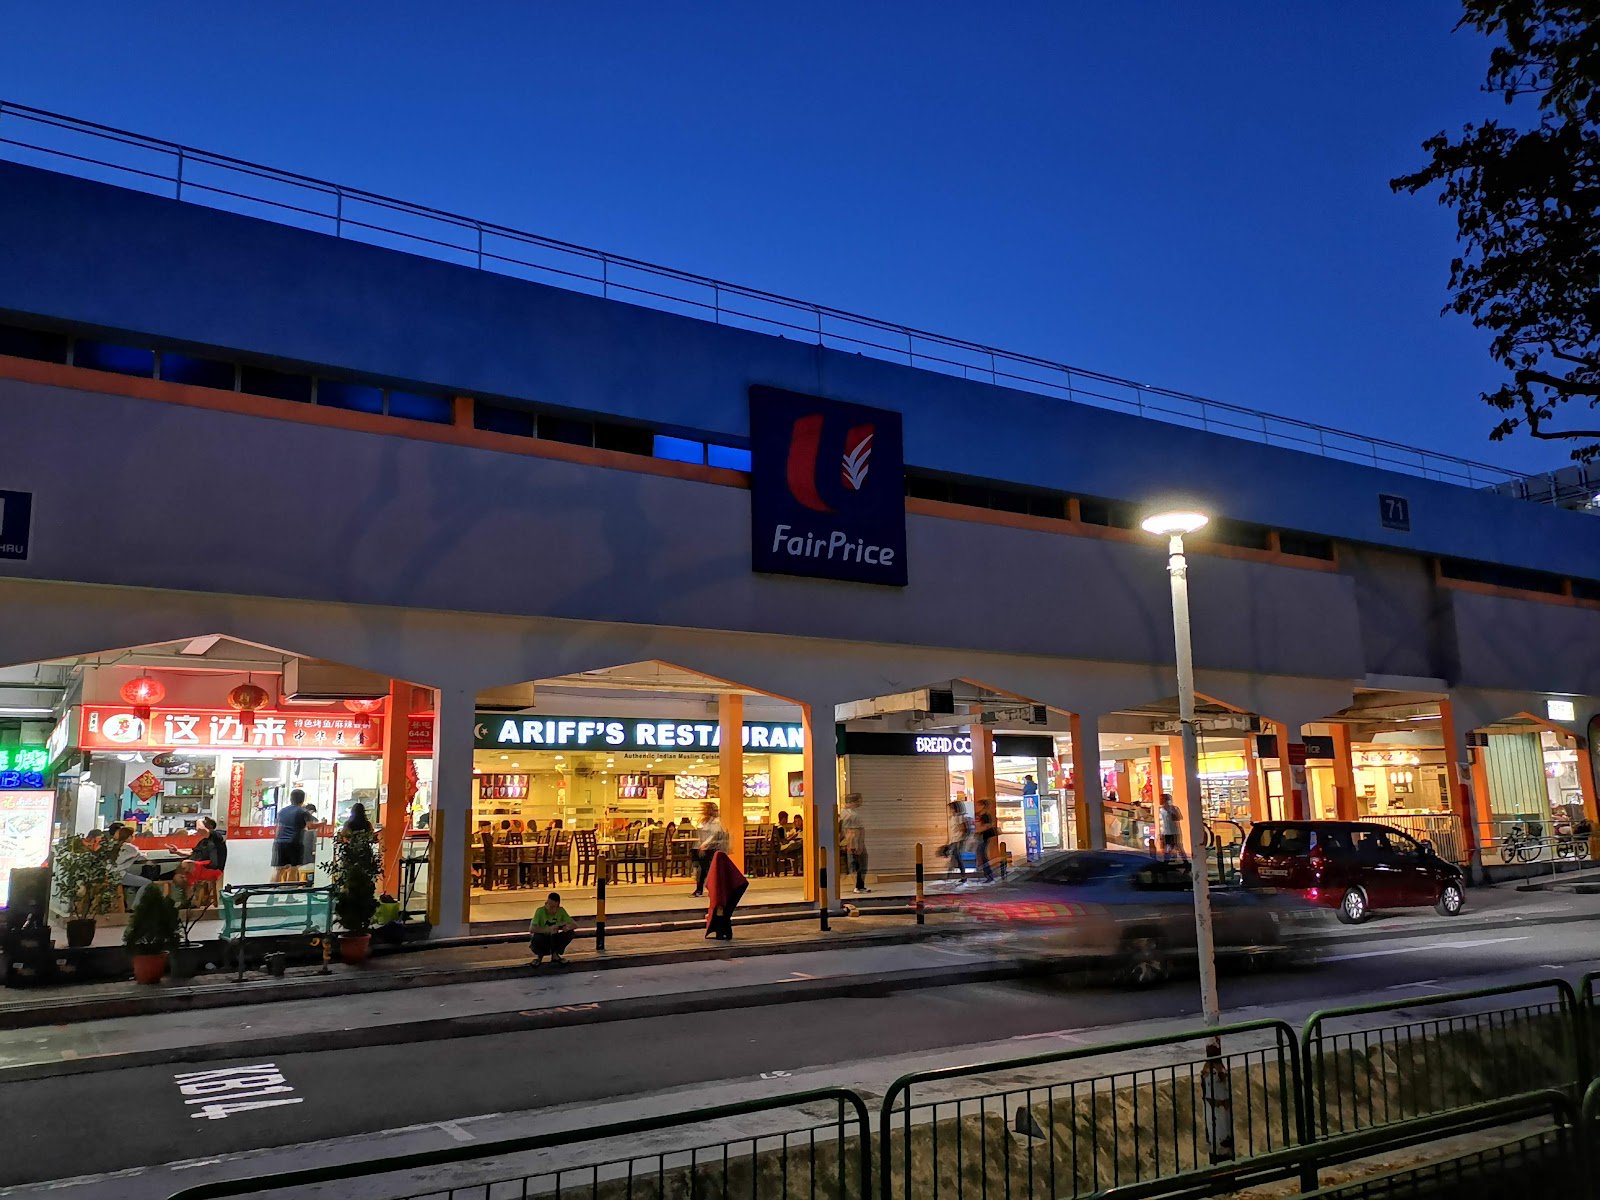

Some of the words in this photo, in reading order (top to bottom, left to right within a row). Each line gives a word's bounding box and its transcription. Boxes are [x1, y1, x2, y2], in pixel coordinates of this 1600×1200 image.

[1385, 500, 1403, 520] 71
[772, 524, 895, 566] FairPrice
[164, 714, 286, 746] 这边来
[497, 719, 625, 745] ARIFF'S
[916, 736, 952, 753] BREAD
[174, 1063, 304, 1120] KB14
